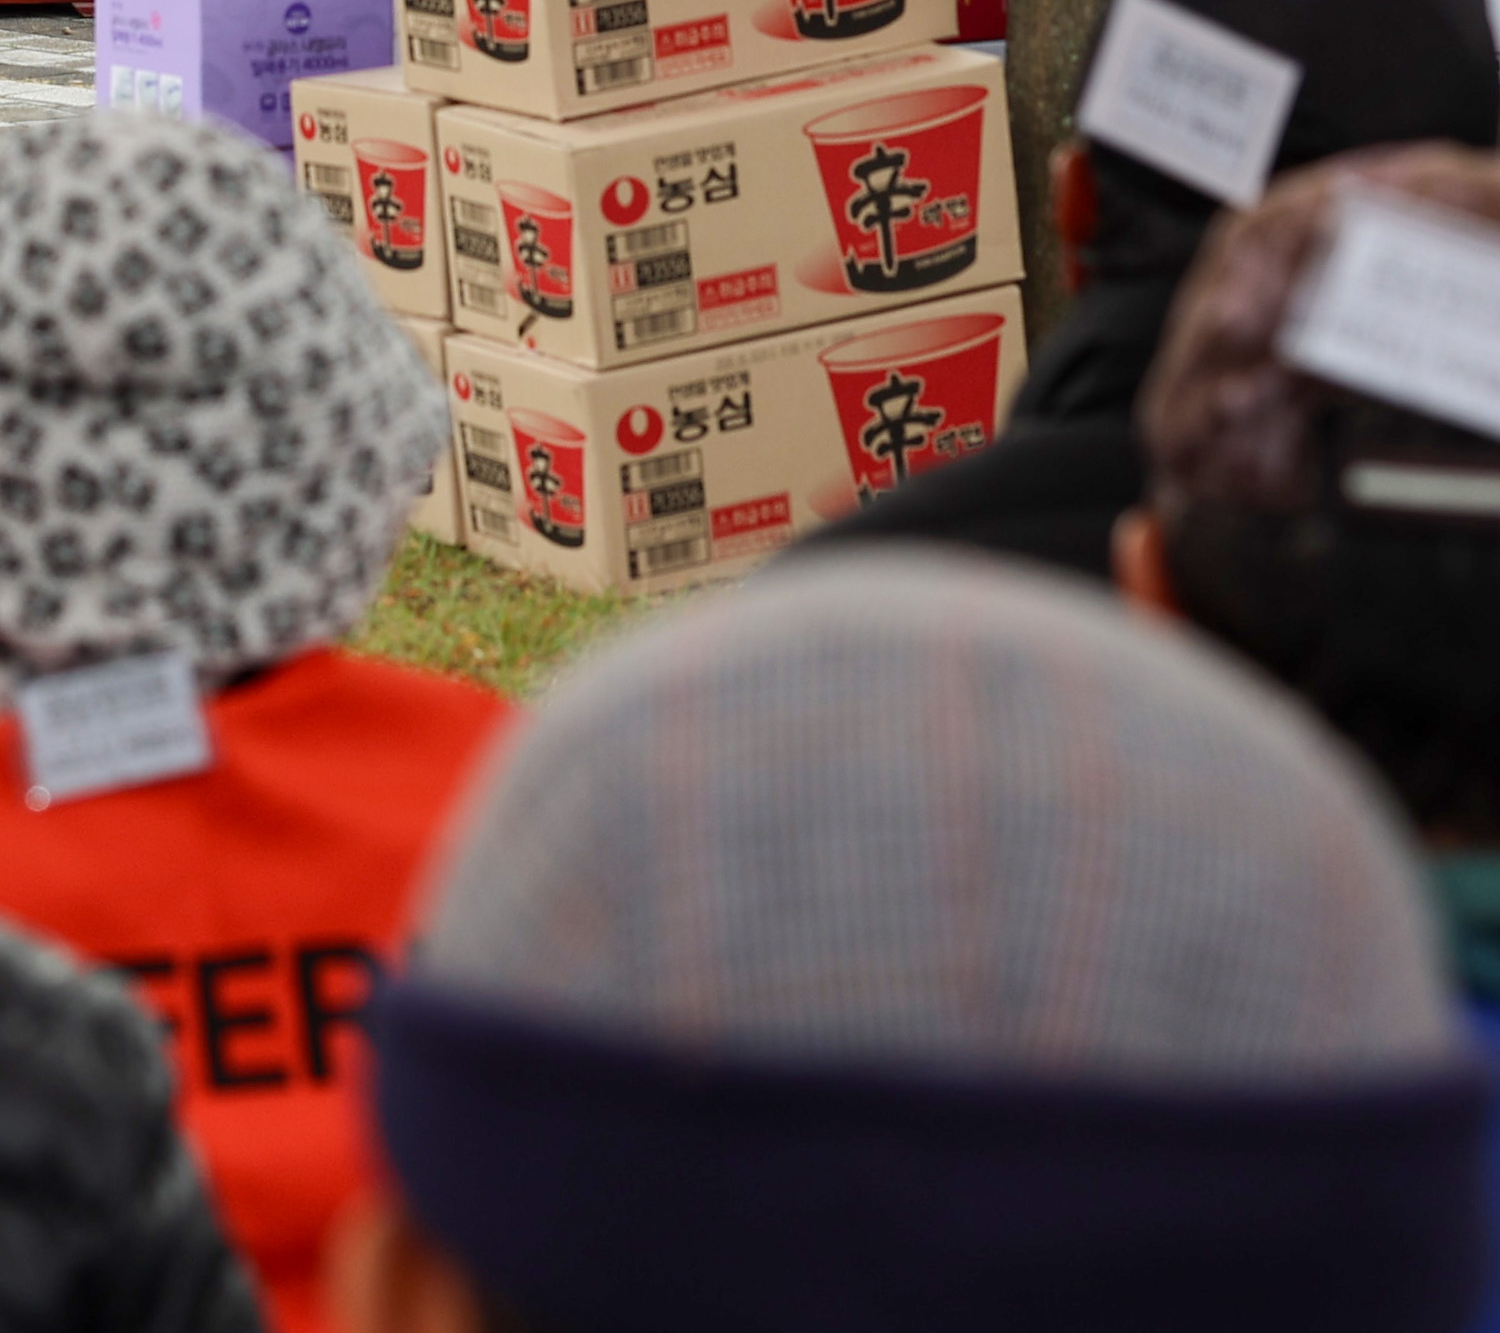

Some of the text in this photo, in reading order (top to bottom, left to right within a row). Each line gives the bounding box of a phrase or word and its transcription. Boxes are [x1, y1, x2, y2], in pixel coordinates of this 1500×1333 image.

[656, 162, 739, 214] 농심
[847, 143, 929, 275] 辛
[670, 391, 754, 444] 농심
[862, 370, 943, 485] 辛
